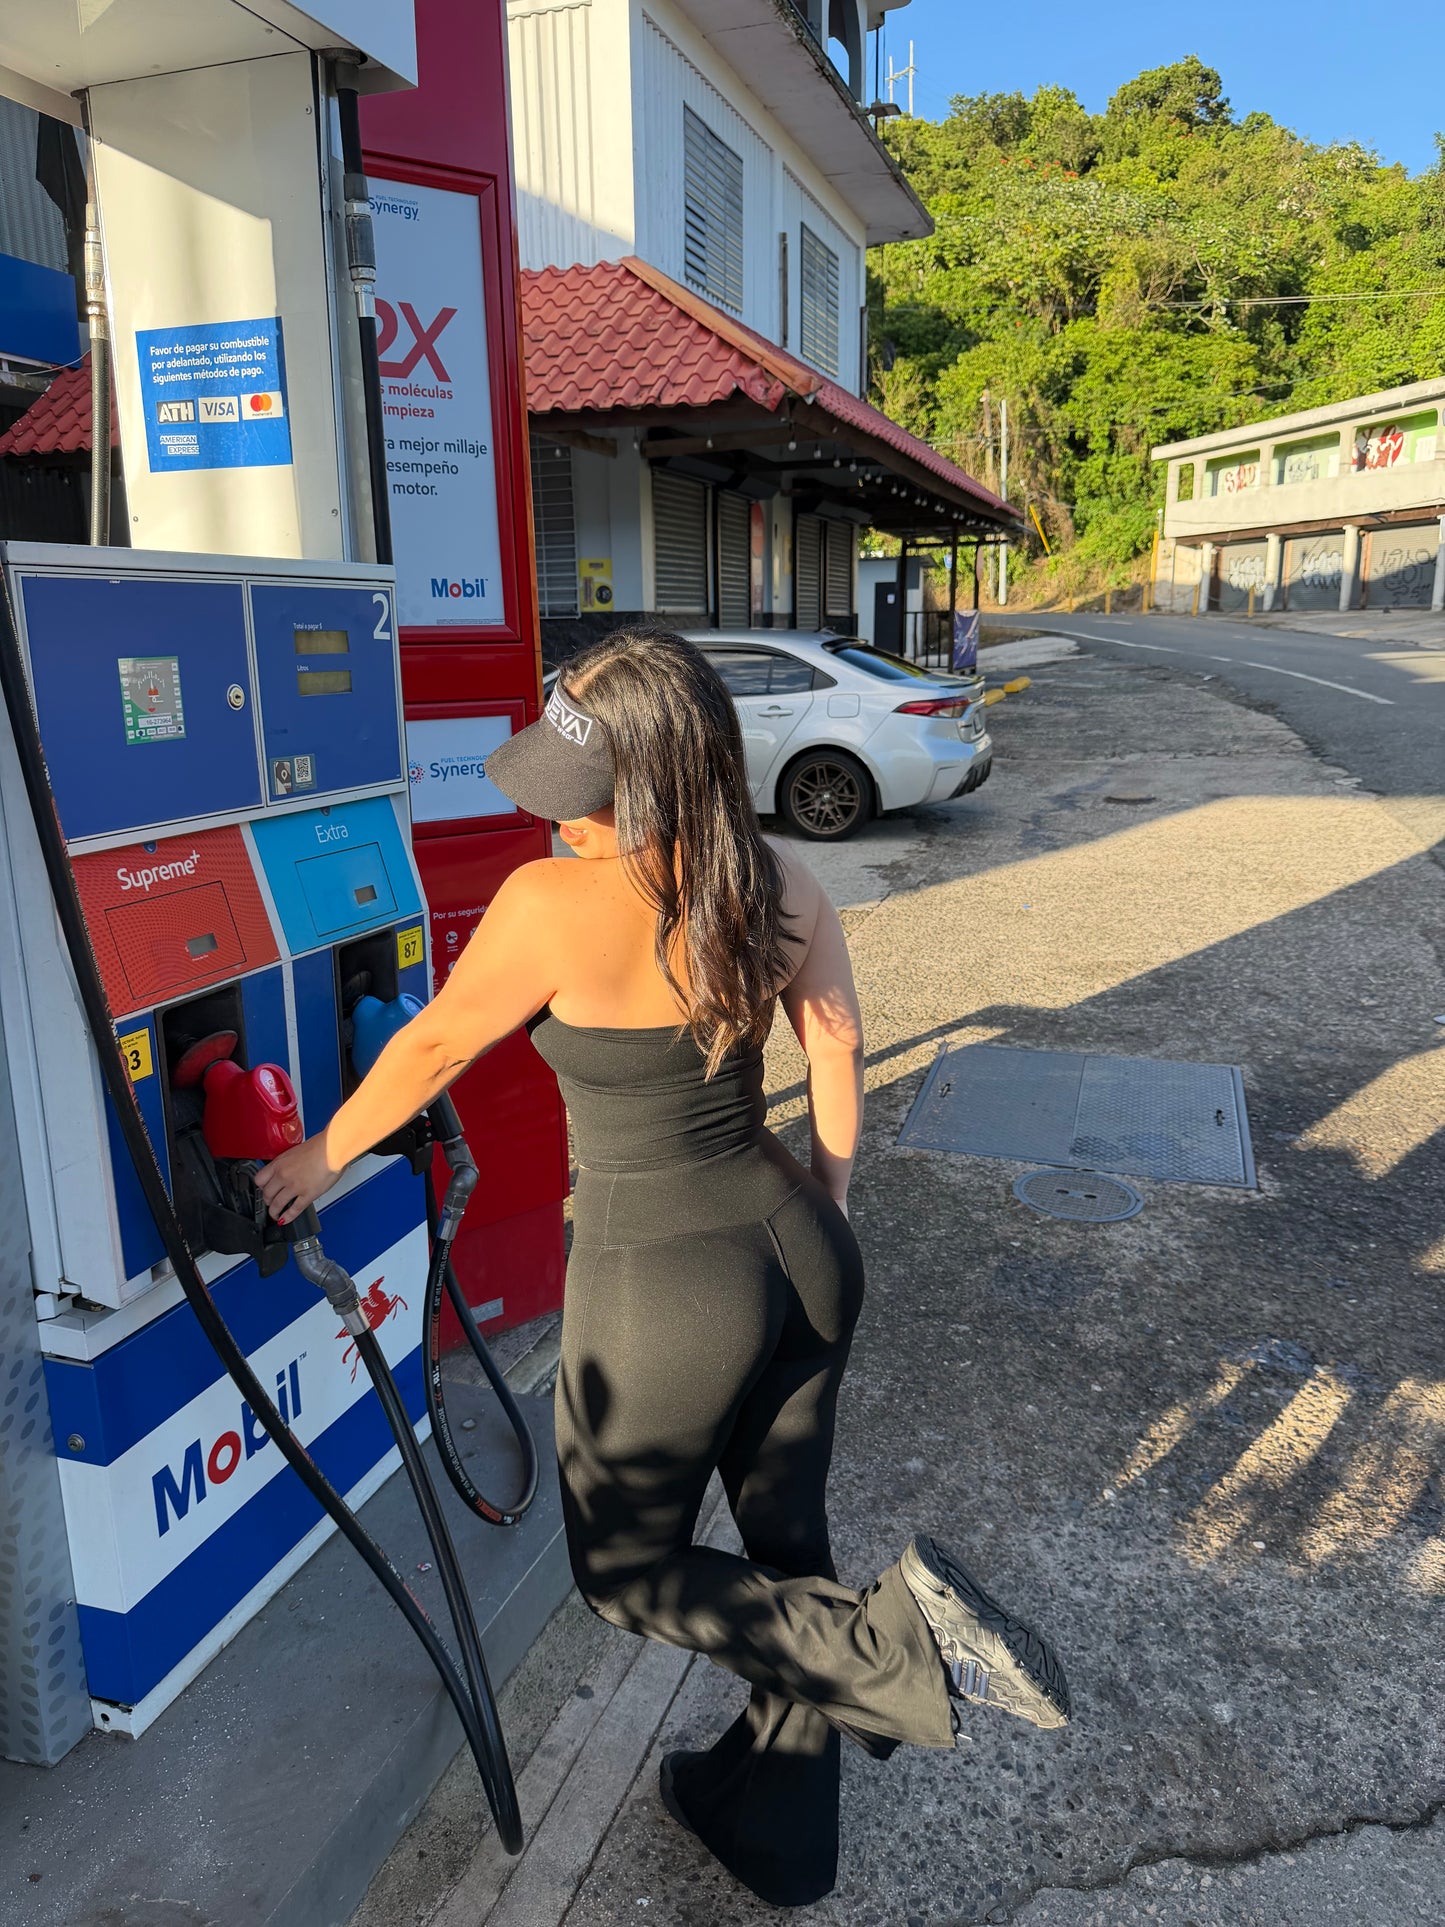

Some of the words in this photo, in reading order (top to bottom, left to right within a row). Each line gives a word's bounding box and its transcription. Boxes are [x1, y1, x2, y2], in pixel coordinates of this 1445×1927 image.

[368, 197, 418, 220] Synergy
[150, 346, 172, 356] Favor
[174, 344, 184, 353] de
[186, 342, 208, 355] pagar
[209, 342, 218, 350] su
[220, 336, 270, 350] combustible
[152, 362, 164, 372] por
[166, 355, 212, 368] adelantado,
[214, 352, 252, 364] utilizando
[254, 350, 266, 360] los
[152, 371, 192, 385] siguientes
[194, 368, 228, 380] métodos
[229, 366, 240, 376] de
[241, 366, 264, 378] pago.
[388, 383, 453, 400] moléculas
[158, 402, 195, 422] ATH
[202, 402, 234, 416] VISA
[383, 402, 434, 420] impieza
[400, 437, 440, 455] mejor
[444, 440, 488, 458] millaje
[386, 461, 458, 478] esempeño
[393, 482, 438, 496] motor.
[431, 578, 486, 598] Mobil
[372, 593, 390, 640] 2
[558, 726, 574, 740] wear
[430, 762, 486, 782] Synerg
[315, 824, 348, 843] Extra
[433, 912, 446, 920] Por
[404, 940, 416, 958] 87
